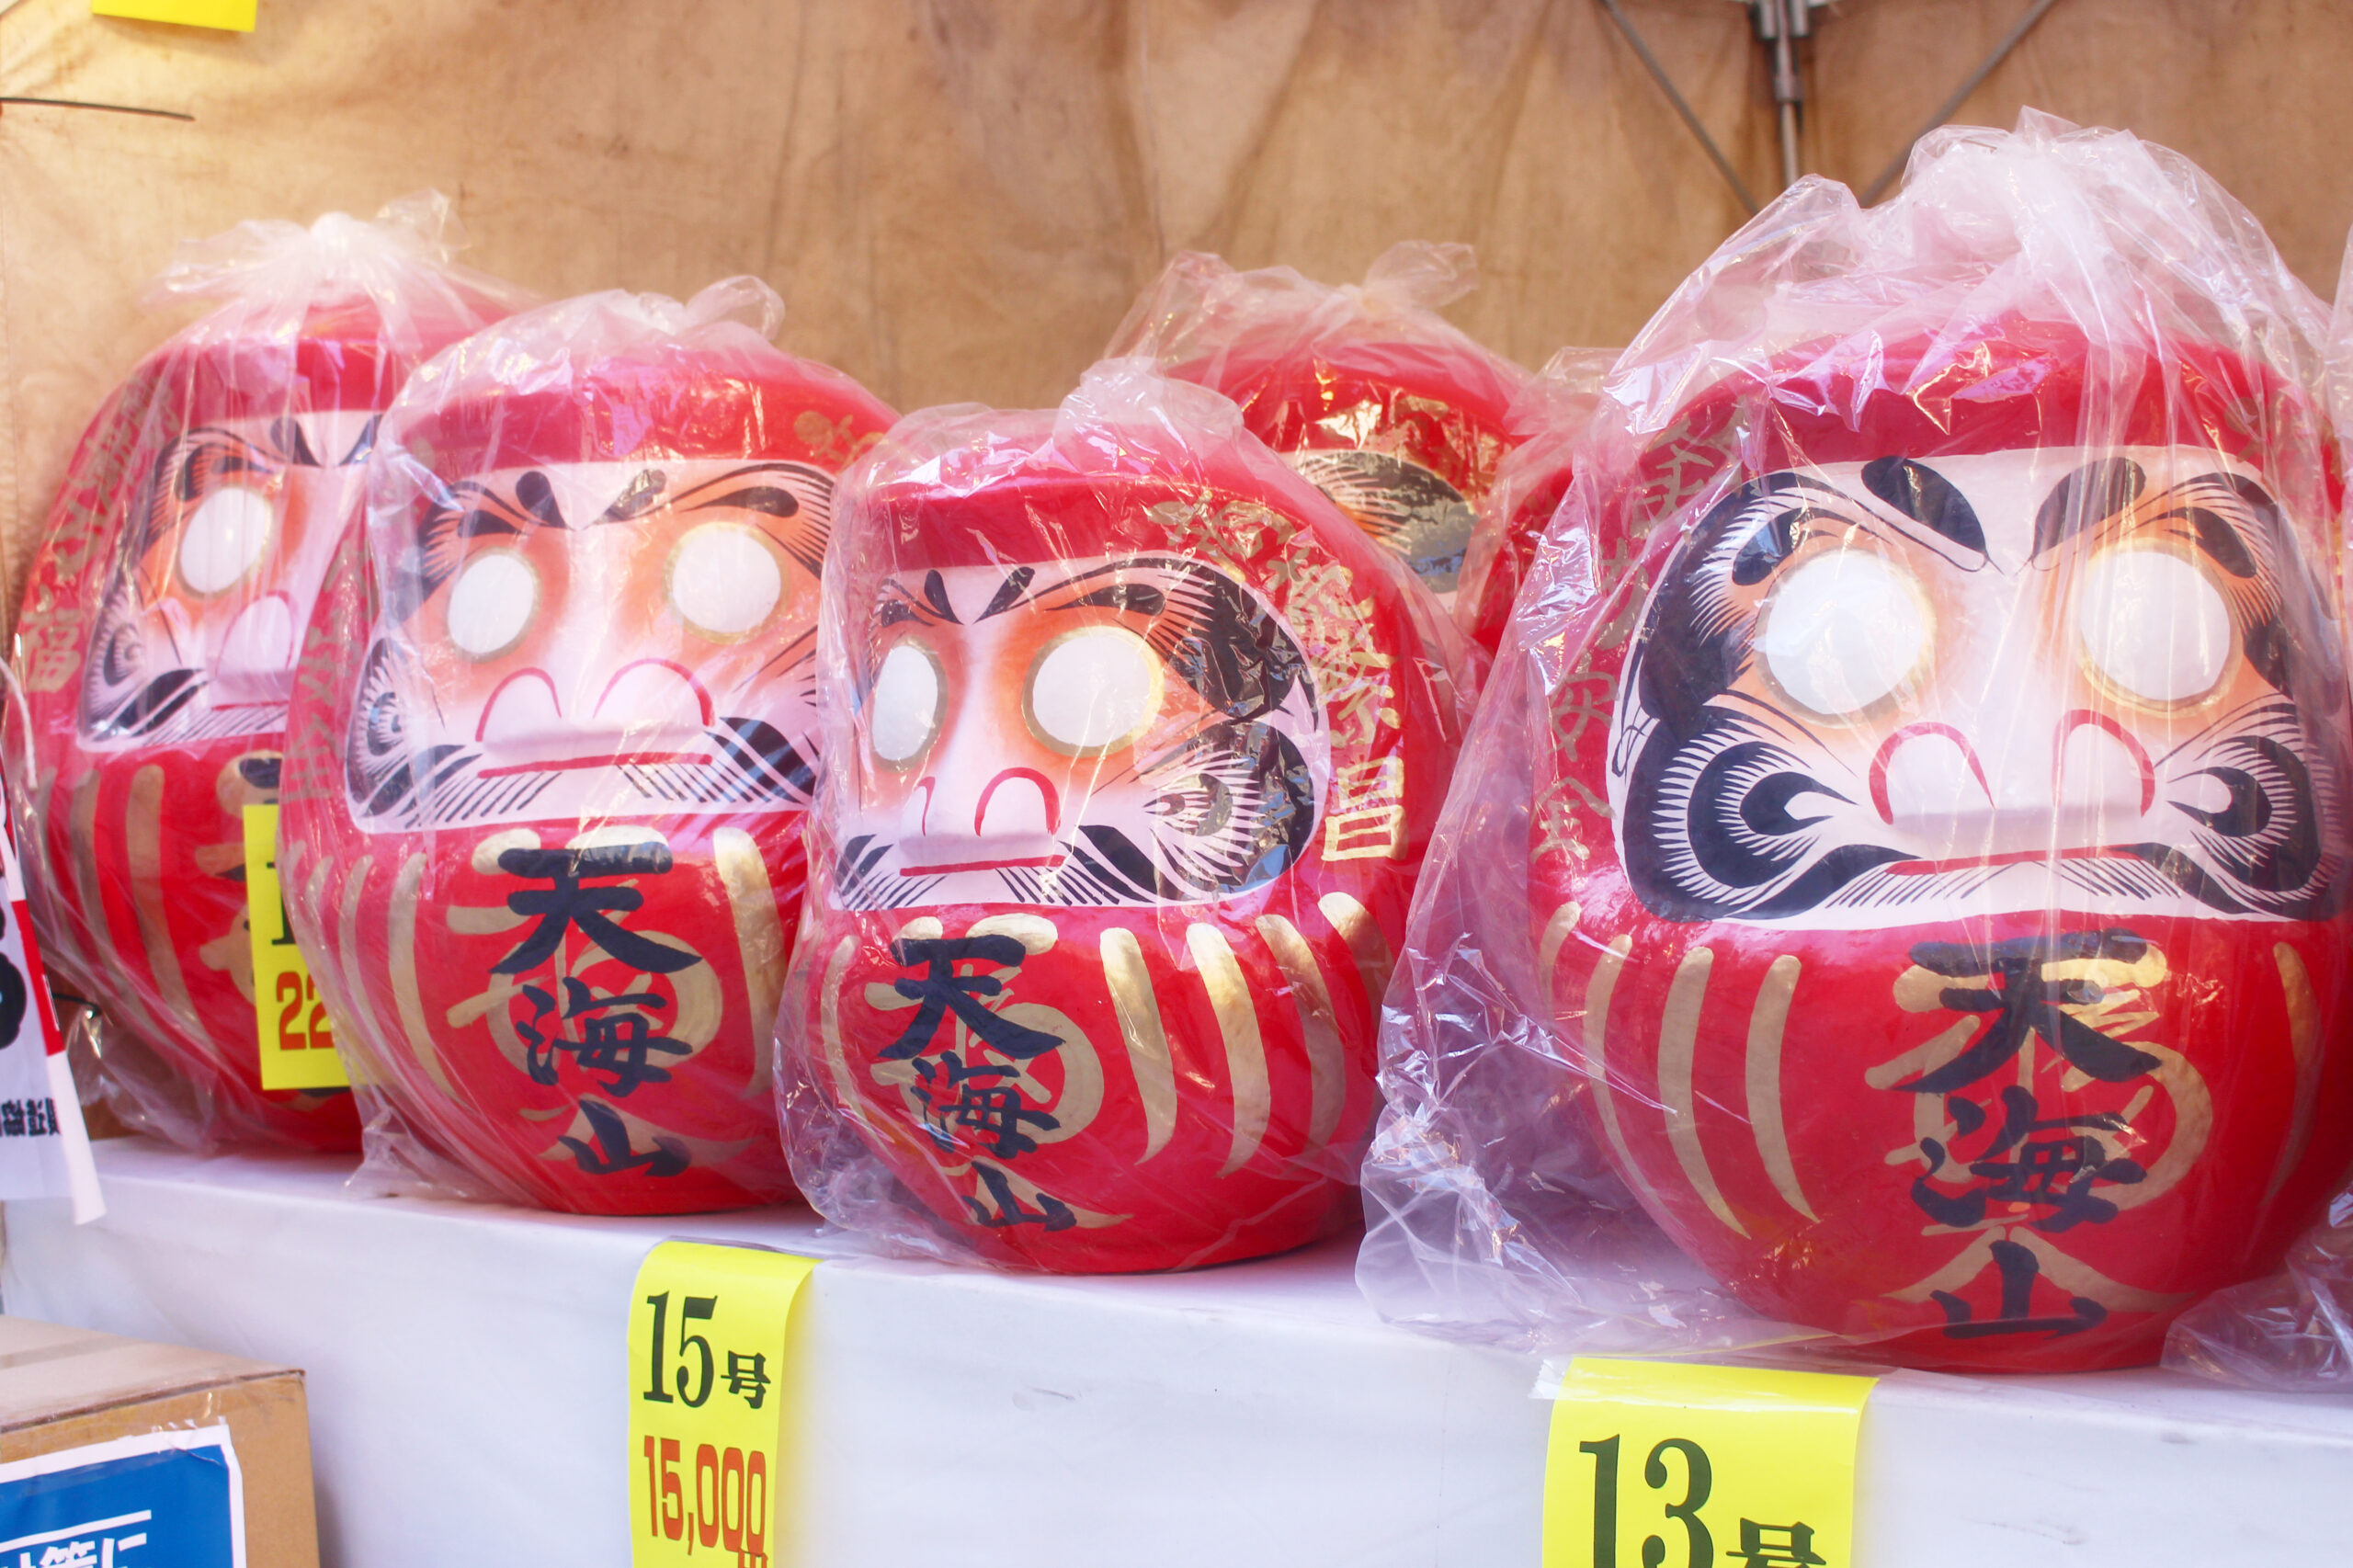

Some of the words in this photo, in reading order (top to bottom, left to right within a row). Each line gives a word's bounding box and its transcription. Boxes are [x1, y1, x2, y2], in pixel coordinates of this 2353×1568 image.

[489, 841, 703, 1178] 天海山
[877, 934, 1077, 1233] 天海山
[1888, 926, 2164, 1340] 天海山
[643, 1290, 772, 1409] 15号
[644, 1435, 767, 1556] 15,000
